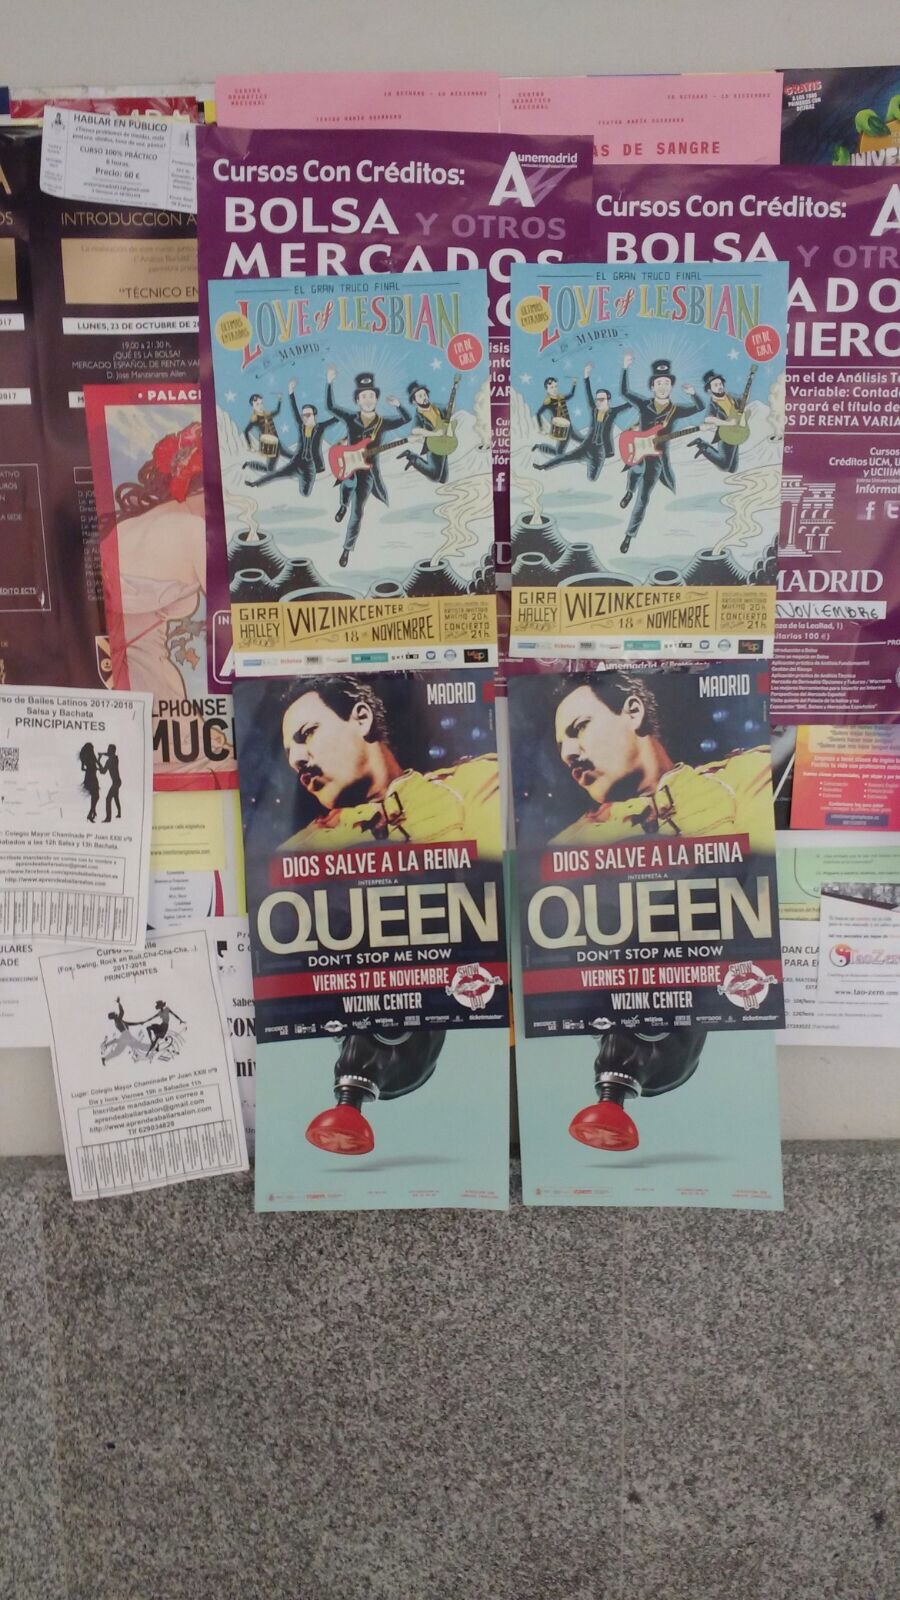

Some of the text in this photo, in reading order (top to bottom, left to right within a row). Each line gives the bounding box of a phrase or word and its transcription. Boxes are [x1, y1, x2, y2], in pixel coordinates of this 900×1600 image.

[74, 113, 111, 126] HABLAR
[113, 119, 126, 128] EN
[80, 146, 103, 154] CURSO
[623, 143, 643, 156] DE
[657, 141, 720, 155] SANGRE
[96, 167, 122, 177] Precio:
[213, 158, 465, 186] Cursos Con Créditos:
[597, 195, 847, 219] Cursos Con Créditos:
[61, 210, 182, 227] INTRODUCCIÓN
[225, 196, 567, 240] BOLSA Y OTROS
[607, 231, 779, 265] BOLSA
[797, 245, 820, 268] Y
[596, 271, 702, 280] EL GRAN TRUCO FINAL
[294, 282, 401, 294] EL GRAN TRUCO FINAL
[77, 319, 191, 331] LUNES, 23 DE OCTUBRE DE
[537, 283, 760, 353] LOVE of LESBIAN
[236, 292, 459, 371] LOVE of LESBIAN
[576, 328, 619, 345] MADRID
[279, 343, 320, 360] MADRID
[72, 359, 185, 369] MERCADO ESPAÑOL DE RENTA
[803, 372, 887, 384] el de Análisis
[791, 387, 850, 398] Variable:
[833, 402, 845, 412] el
[848, 402, 882, 414] título
[800, 415, 860, 427] DE RENTA
[829, 456, 868, 467] Créditos
[519, 592, 556, 604] GIRA
[240, 607, 279, 621] GIRA
[565, 592, 681, 621] WIZINKCENTER
[287, 604, 404, 637] WIZINKCENTER
[519, 607, 557, 622] HALLEY
[620, 604, 710, 629] 18 NOVIEMBRE
[721, 612, 767, 621] CONCIERTO
[240, 623, 280, 638] HALLEY
[345, 615, 434, 642] 18 NOVIEMBRE
[444, 622, 490, 631] CONCIERTO
[804, 632, 819, 640] 100
[427, 682, 476, 705] MADRID
[699, 674, 750, 698] MADRID
[28, 695, 55, 705] Bailes
[57, 696, 88, 707] Latinos
[90, 699, 133, 710] 2017-2018
[26, 706, 94, 718] Salsa Bachata
[15, 717, 106, 731] PRINCIPIANTES
[283, 848, 471, 879] DIOS SALVE A LA REINA
[553, 842, 743, 873] DIOS SALVE A LA REINA
[257, 881, 499, 955] QUEEN
[527, 875, 772, 950] QUEEN
[356, 952, 390, 965] STOP
[394, 950, 413, 962] ME
[417, 948, 452, 961] NOW
[625, 947, 659, 960] STOP
[664, 946, 683, 959] ME
[688, 945, 723, 958] NOW
[76, 957, 118, 971] Swing, Rock
[113, 961, 147, 972] 2017-2018
[784, 959, 809, 967] PARA
[104, 967, 158, 982] PRINCIPIANTES
[313, 967, 449, 992] VIERNES 17 DE NOVIEMBRE
[581, 965, 721, 987] VIERNES 17 DE NOVIEMBRE
[343, 992, 422, 1013] WIZINK CENTER
[611, 991, 693, 1011] WIZINK CENTER
[92, 1105, 125, 1115] Inscribete
[127, 1098, 163, 1110] mandando
[175, 1091, 198, 1100] correo
